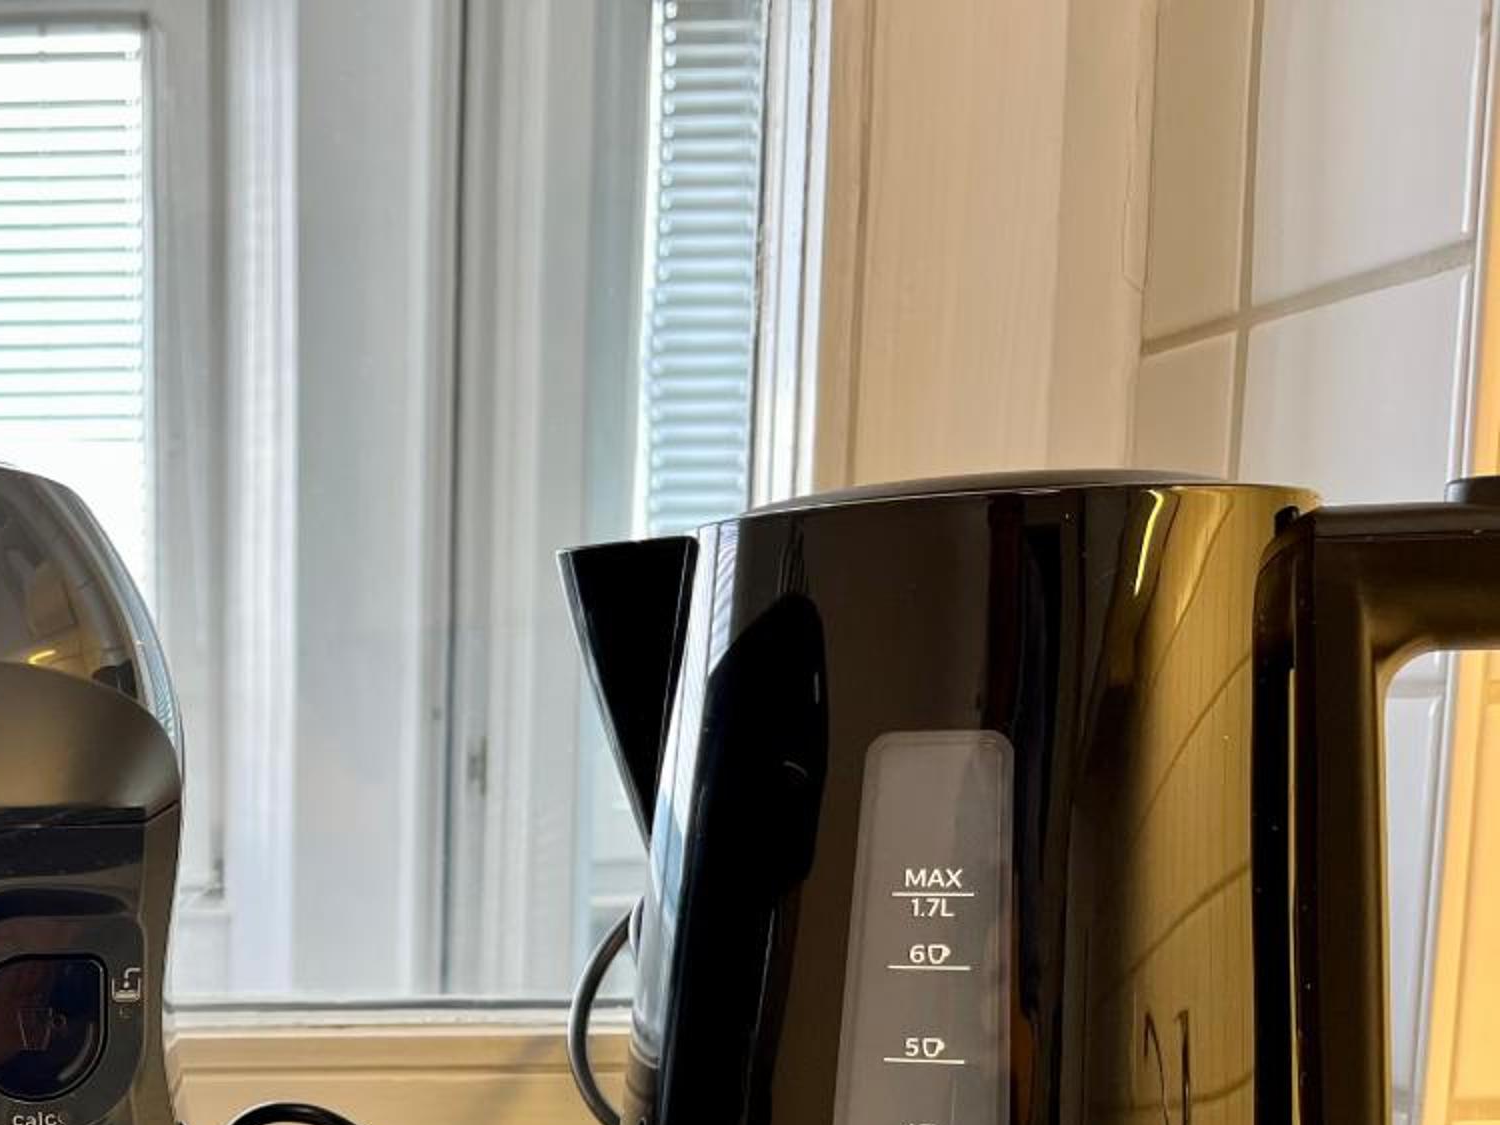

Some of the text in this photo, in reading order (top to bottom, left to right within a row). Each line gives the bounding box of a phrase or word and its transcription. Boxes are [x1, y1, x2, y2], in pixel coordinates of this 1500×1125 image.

[904, 868, 964, 888] MAX
[911, 898, 955, 917] 1.7L
[909, 944, 925, 963] 6
[905, 1037, 919, 1057] 5
